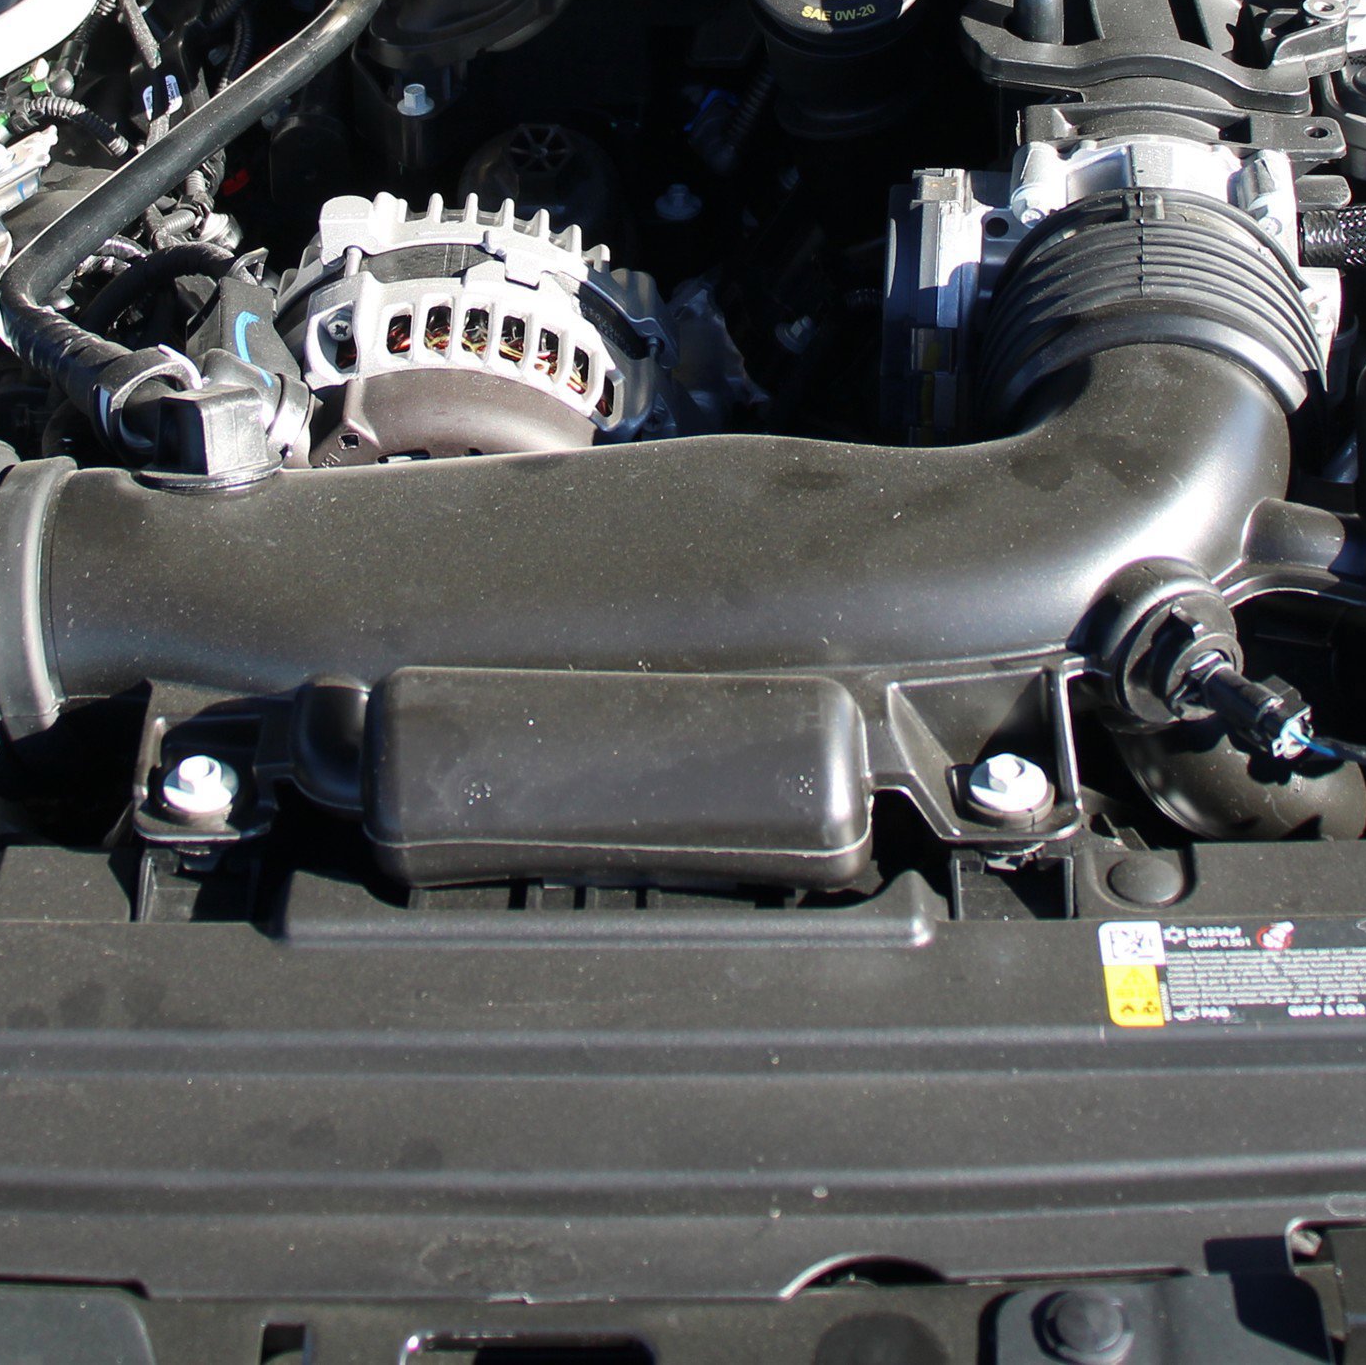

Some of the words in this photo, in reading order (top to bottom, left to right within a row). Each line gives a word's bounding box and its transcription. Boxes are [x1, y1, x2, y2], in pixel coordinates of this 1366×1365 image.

[801, 5, 832, 22] SAE
[834, 4, 876, 22] 0W-20
[1186, 926, 1242, 938] R-1234yf
[1187, 937, 1218, 948] GWP
[1287, 1004, 1321, 1017] GWP
[1323, 1005, 1335, 1016] &
[1336, 1003, 1366, 1016] CO2
